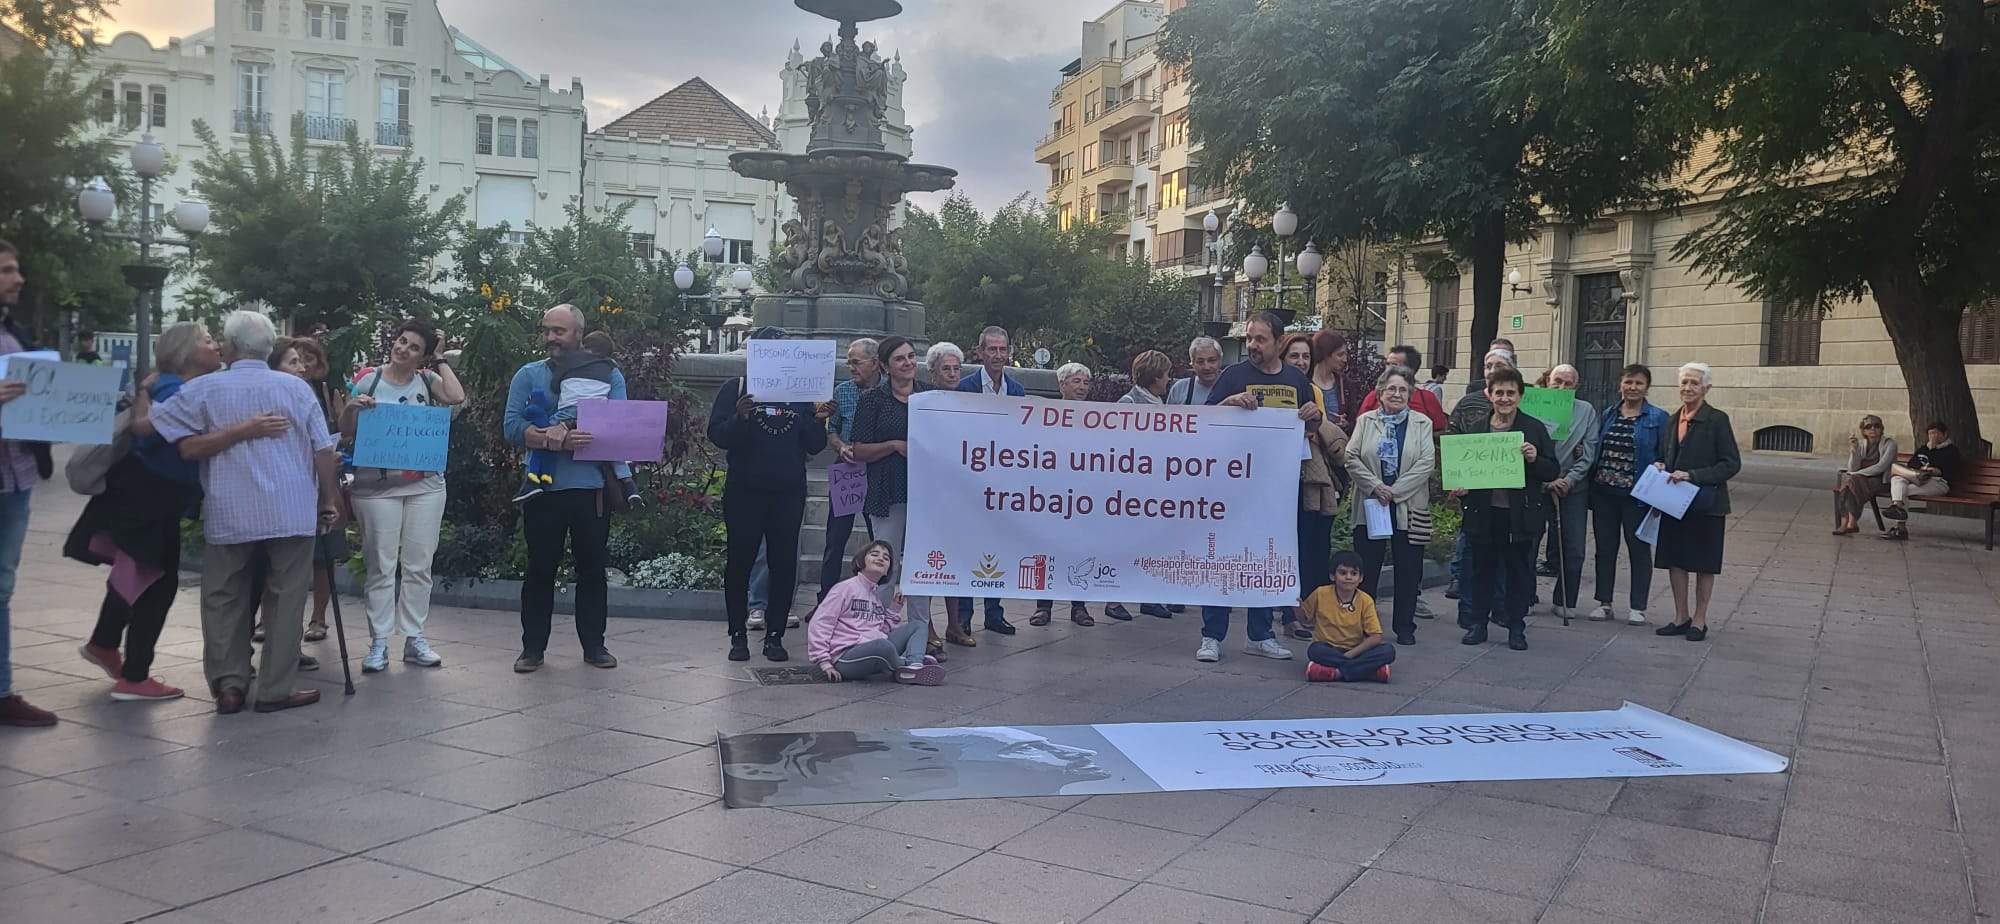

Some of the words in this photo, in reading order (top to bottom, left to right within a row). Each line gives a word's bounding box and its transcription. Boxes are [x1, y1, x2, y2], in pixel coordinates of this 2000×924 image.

[1020, 405, 1034, 426] 7
[1043, 407, 1073, 428] DE
[1083, 410, 1198, 434] OCTUBRE
[961, 440, 1057, 473] Iglesia
[1070, 447, 1153, 476] unida
[1166, 455, 1217, 481] por
[1228, 453, 1252, 479] el
[1460, 447, 1518, 463] DIGNAS
[984, 486, 1093, 519] trabajo
[1105, 490, 1226, 521] decente
[1133, 557, 1263, 573] #Iglesiaporeltrabajodecente
[914, 570, 957, 580] Cáritas
[971, 580, 1005, 589] CONFER
[1239, 569, 1296, 593] trabajo
[1207, 727, 1410, 741] TRABAJO
[1419, 723, 1557, 735] DIGNO
[1223, 735, 1453, 751] SOCIEDAD
[1463, 730, 1663, 744] DECENTE
